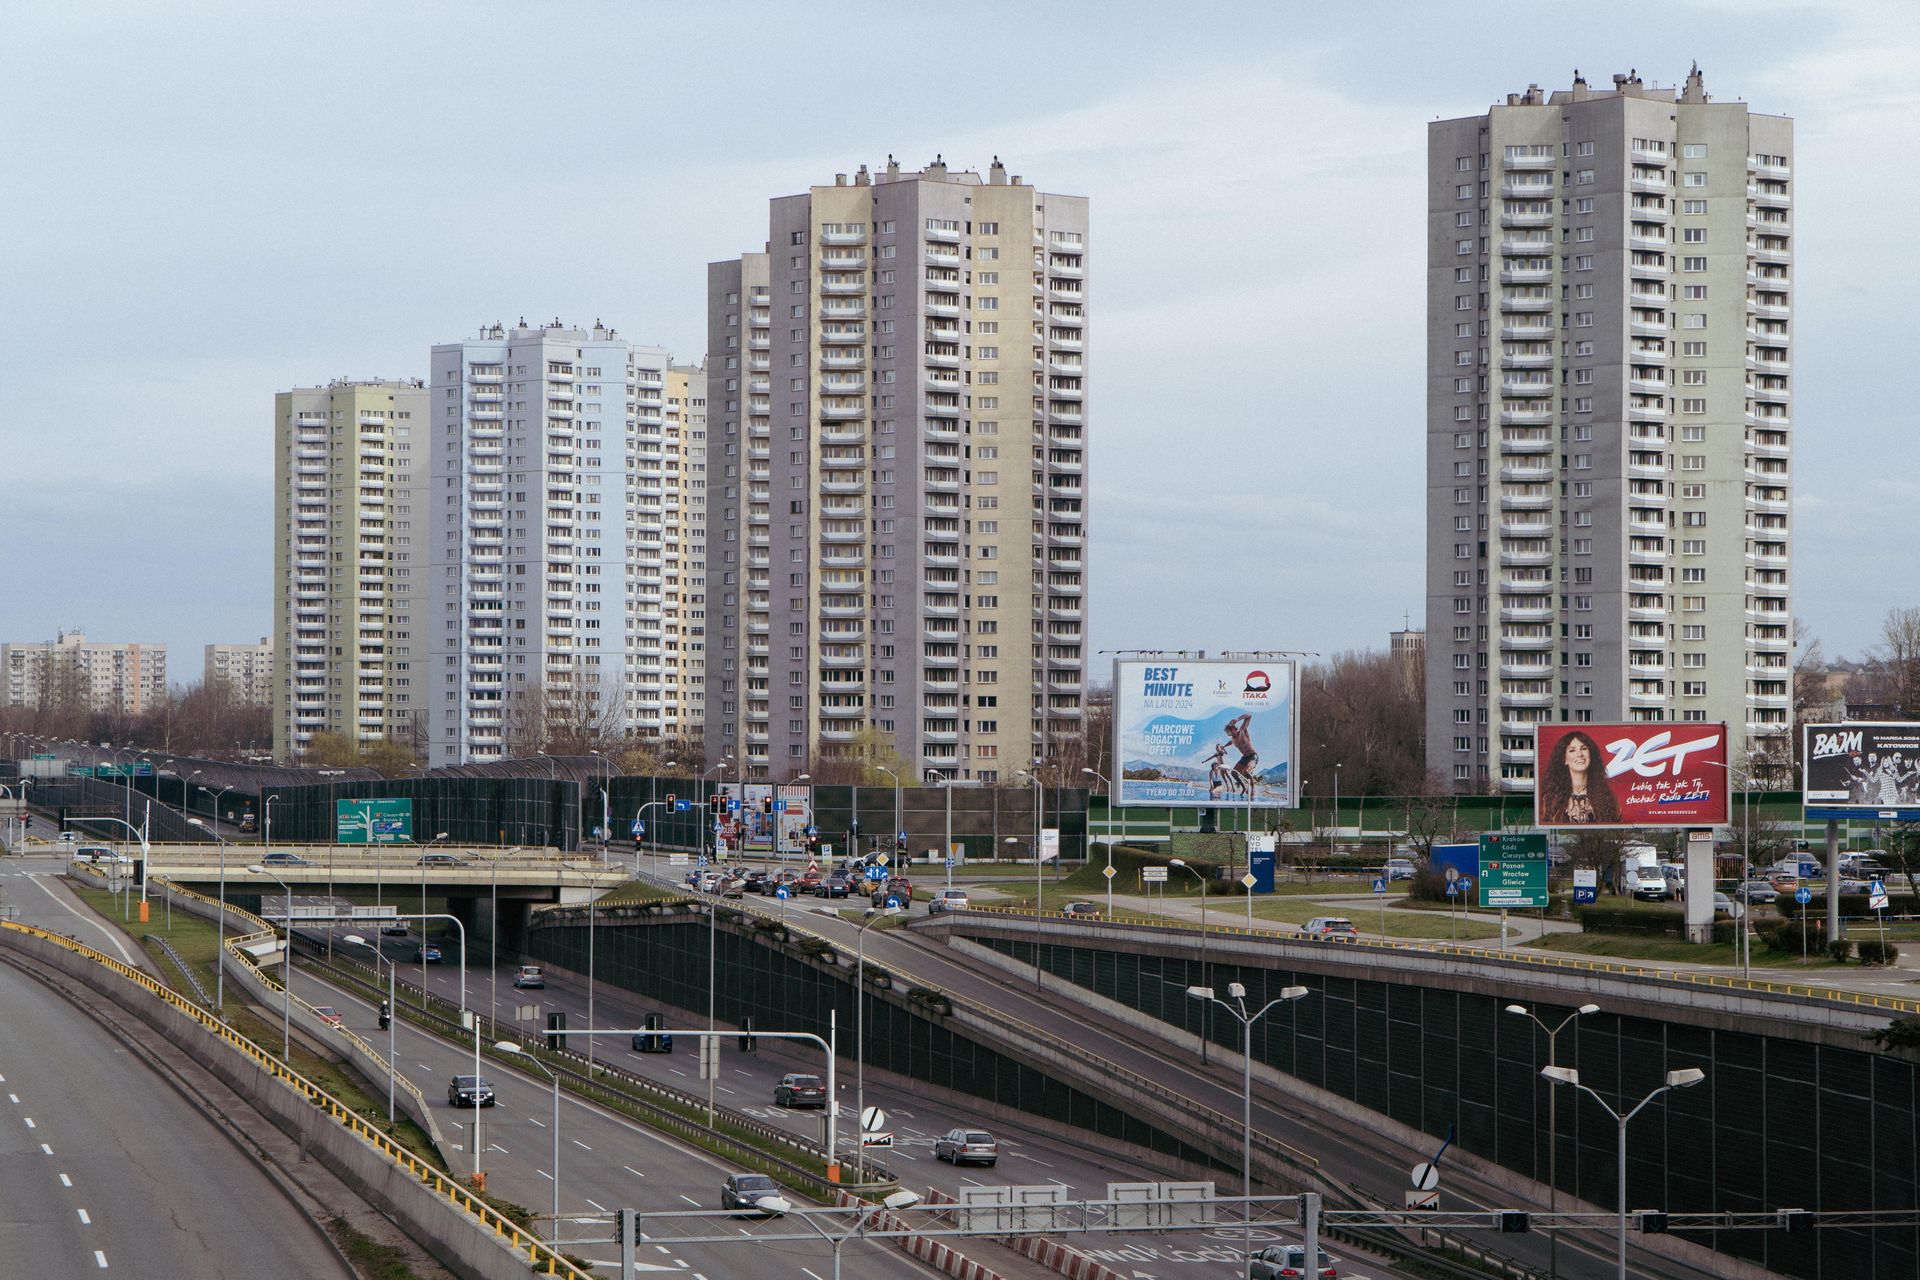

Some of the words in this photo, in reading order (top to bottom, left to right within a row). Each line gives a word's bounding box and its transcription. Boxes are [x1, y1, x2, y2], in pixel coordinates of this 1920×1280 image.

[1143, 667, 1178, 681] BEST
[1143, 683, 1194, 697] MINUTE
[1143, 699, 1154, 709] NA
[1155, 699, 1174, 709] LATO
[1174, 699, 1193, 709] 2024
[1151, 724, 1196, 735] MARCOWE
[1144, 735, 1193, 745] BOGACTWO
[1813, 730, 1863, 755] BAJM
[1149, 745, 1177, 756] OFERT
[1605, 730, 1720, 779] ZET
[1631, 781, 1653, 792] Lubię
[1656, 780, 1671, 790] tak
[1669, 779, 1689, 794] jak
[1146, 788, 1167, 797] TYLKO
[1658, 792, 1682, 802] Radia
[1683, 790, 1710, 801] ZET!
[1691, 831, 1711, 840] ams
